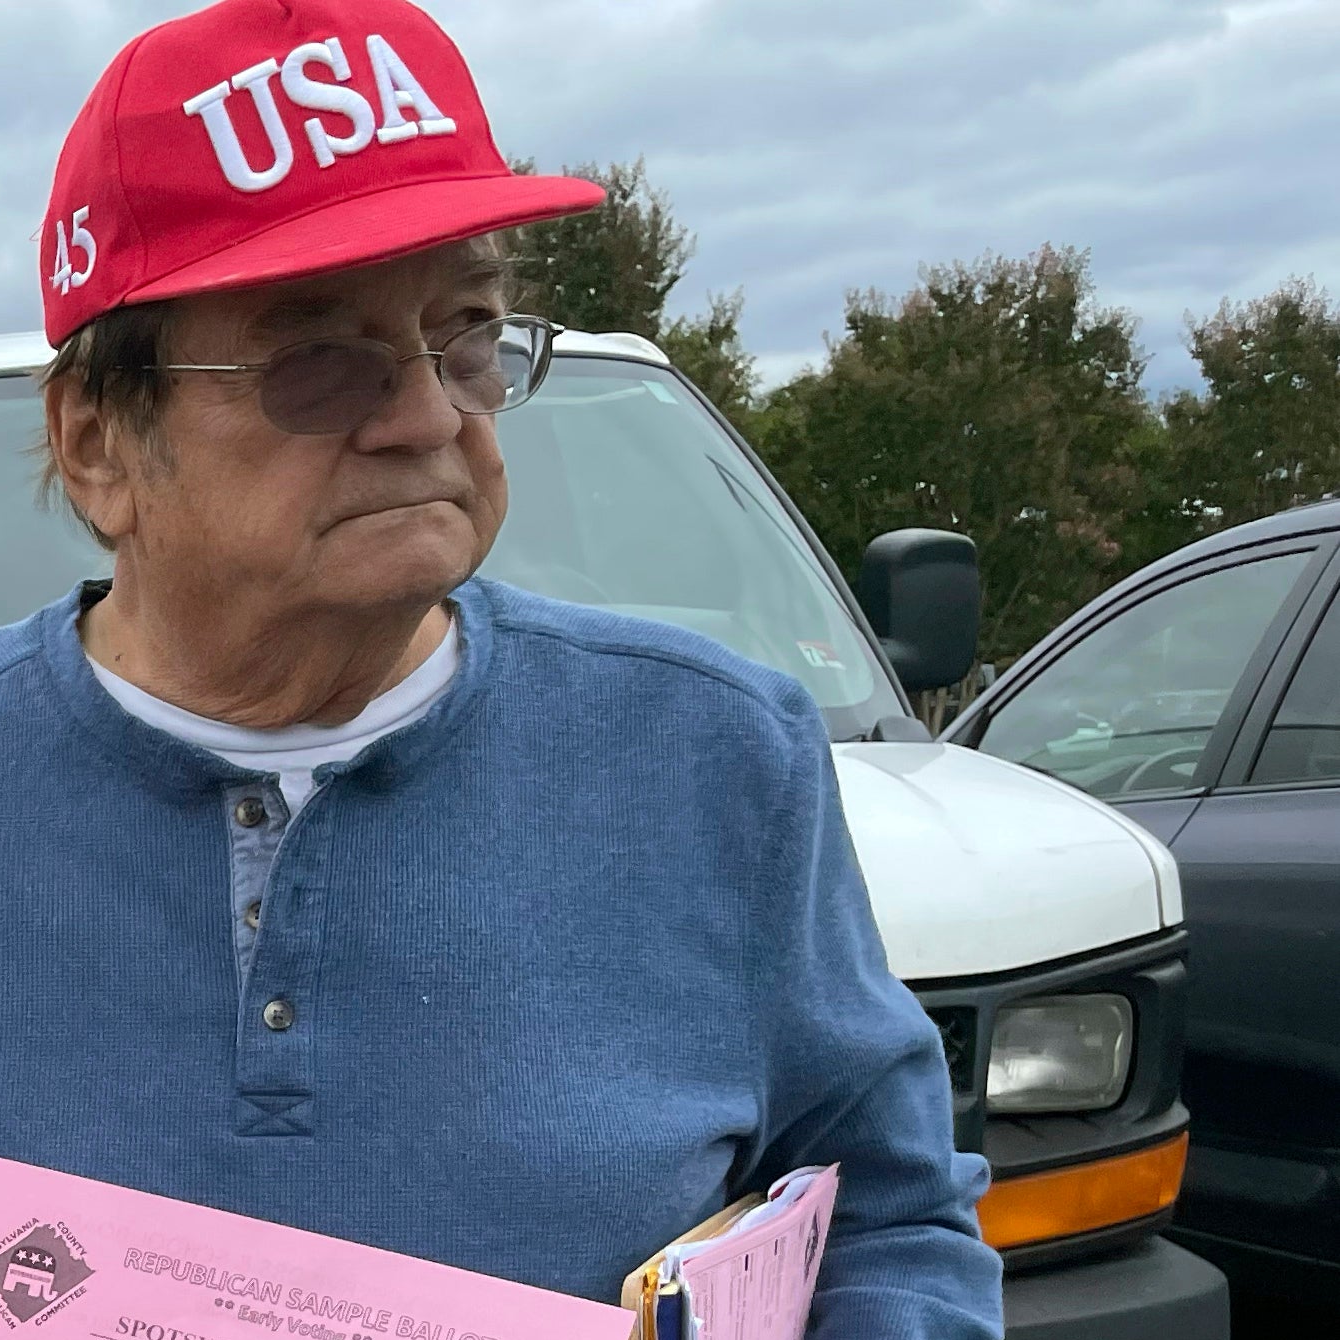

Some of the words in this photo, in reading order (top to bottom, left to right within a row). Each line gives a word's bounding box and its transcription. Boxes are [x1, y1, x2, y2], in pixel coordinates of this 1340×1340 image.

[183, 34, 456, 192] USA
[49, 205, 97, 296] 45
[56, 1221, 88, 1258] COUNTY
[34, 1286, 87, 1327] COMMITTEE
[122, 1246, 283, 1306] REPUBLICAN
[283, 1286, 393, 1334] SAMPLE
[235, 1304, 285, 1332] Early
